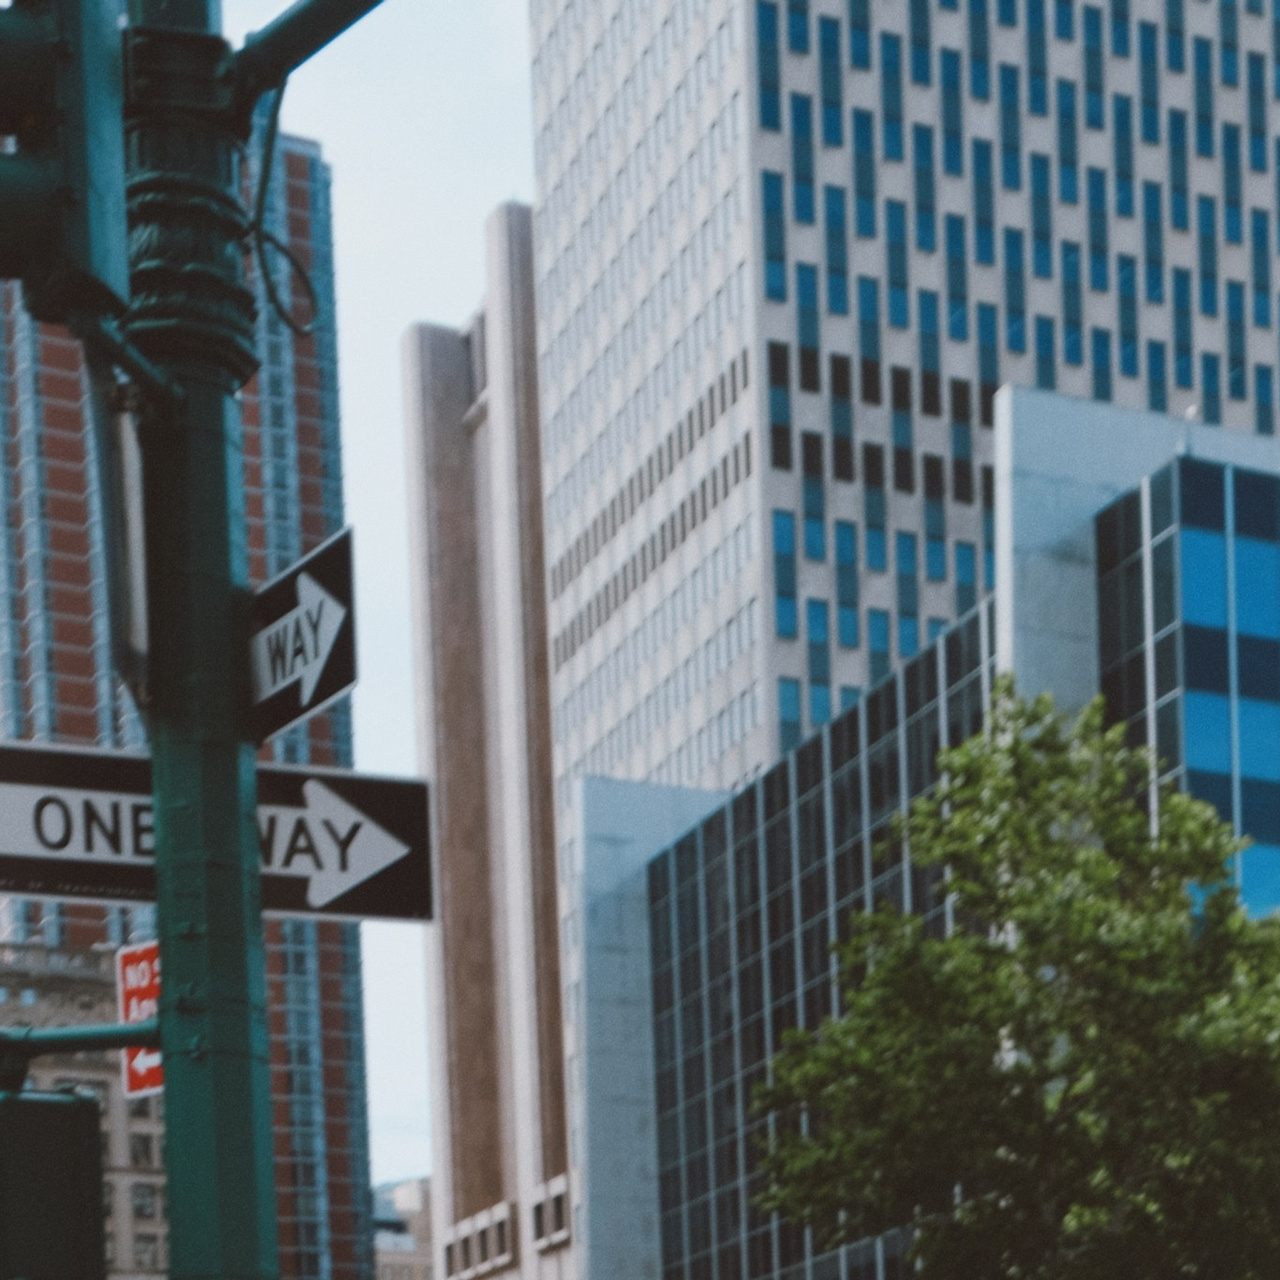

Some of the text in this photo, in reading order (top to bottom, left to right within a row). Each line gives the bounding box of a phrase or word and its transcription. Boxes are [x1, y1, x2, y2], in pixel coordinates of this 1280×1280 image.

[266, 598, 325, 687] WAY
[34, 795, 155, 857] ONE
[125, 959, 150, 990] NO
